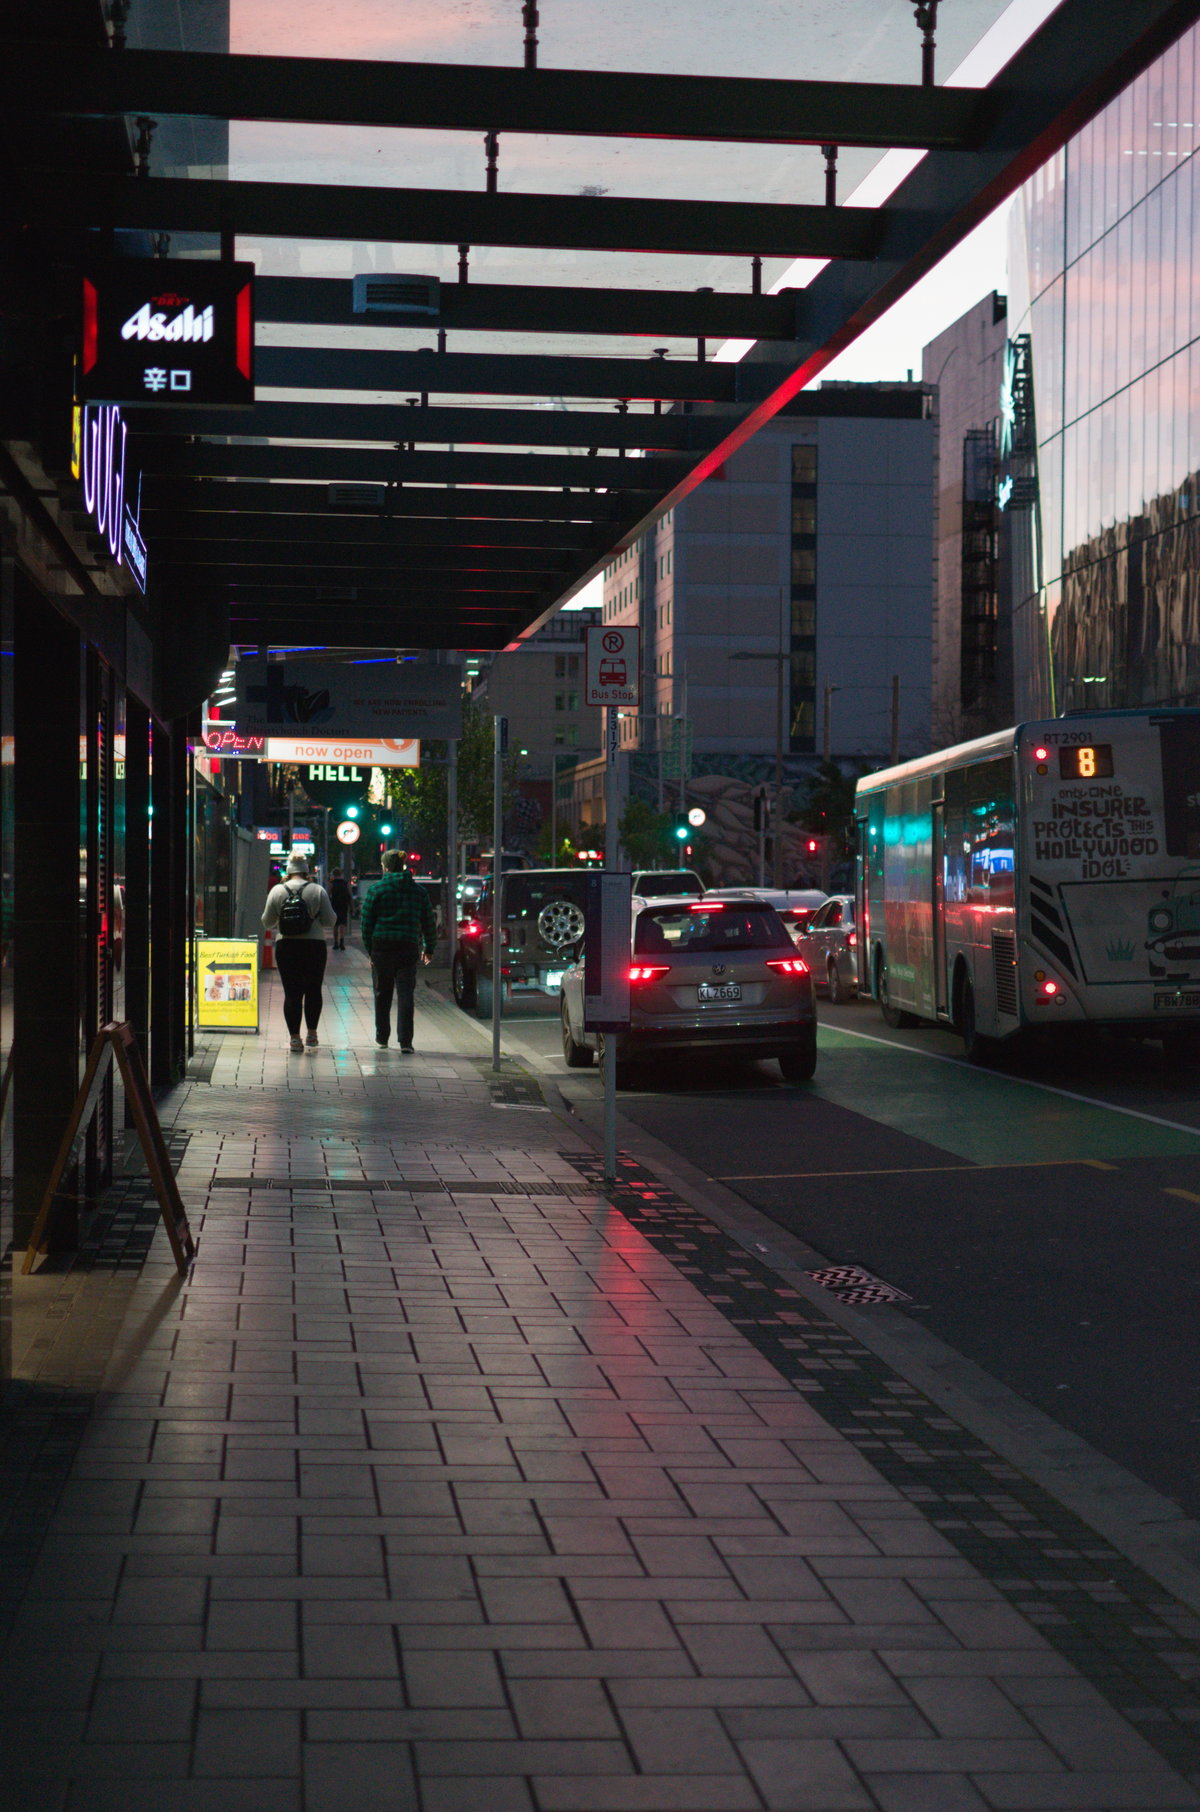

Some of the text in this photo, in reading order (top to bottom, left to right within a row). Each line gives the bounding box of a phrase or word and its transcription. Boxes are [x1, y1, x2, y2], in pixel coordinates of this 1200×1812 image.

[121, 302, 213, 342] Asahi
[143, 367, 191, 391] 辛口
[592, 690, 634, 700] Bus Stop
[247, 713, 264, 724] The
[246, 725, 350, 736] Christchurch Doctors
[1043, 731, 1093, 746] RT2901
[205, 731, 263, 749] OPEN
[295, 745, 373, 760] now open
[1077, 748, 1096, 777] 8
[309, 764, 362, 781] HELL
[1059, 787, 1086, 799] only
[1035, 838, 1159, 860] HOLLYWOOD
